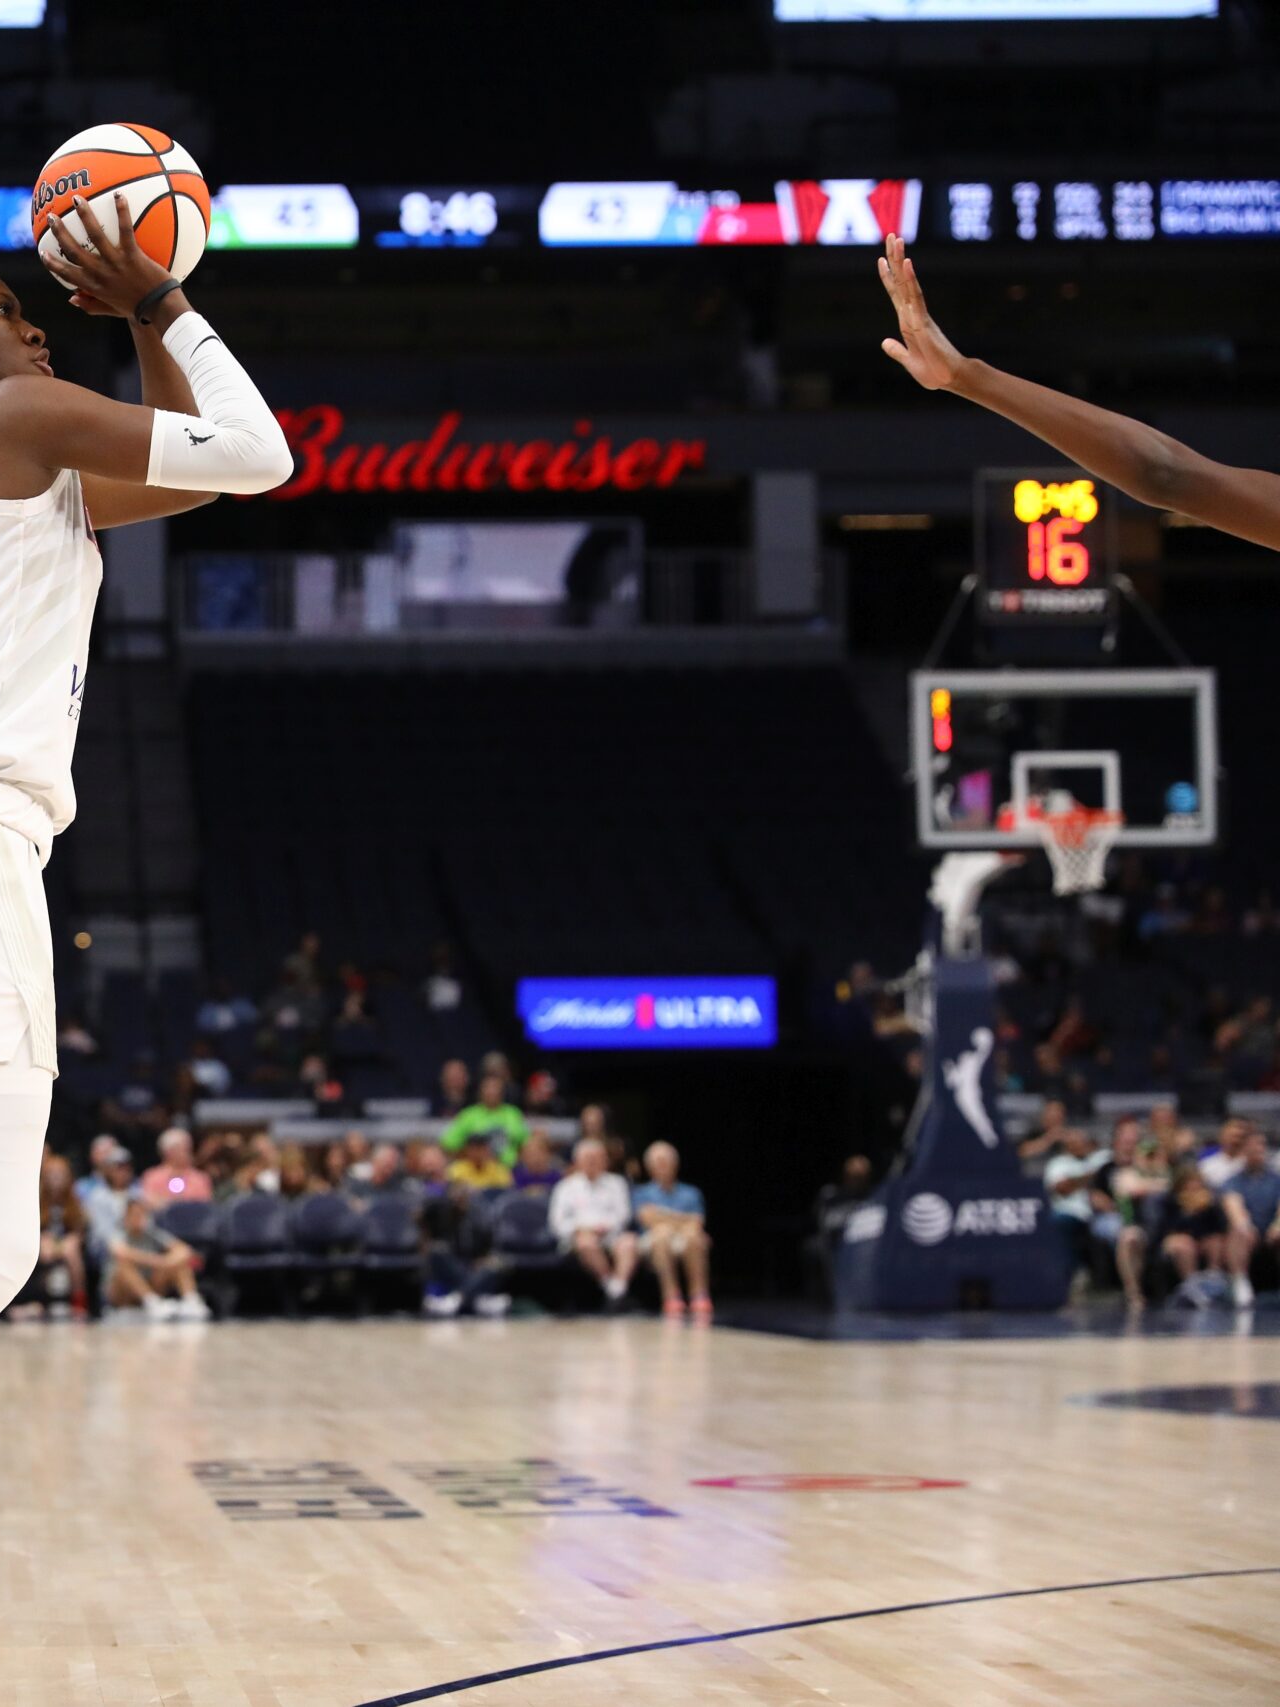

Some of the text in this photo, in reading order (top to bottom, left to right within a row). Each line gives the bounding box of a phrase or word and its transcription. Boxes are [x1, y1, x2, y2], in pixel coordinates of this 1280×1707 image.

[31, 169, 91, 216] ilson
[275, 404, 706, 499] Budweiser
[1027, 516, 1089, 585] 16
[654, 995, 762, 1029] ULTRA
[953, 1198, 1042, 1235] AT&T
